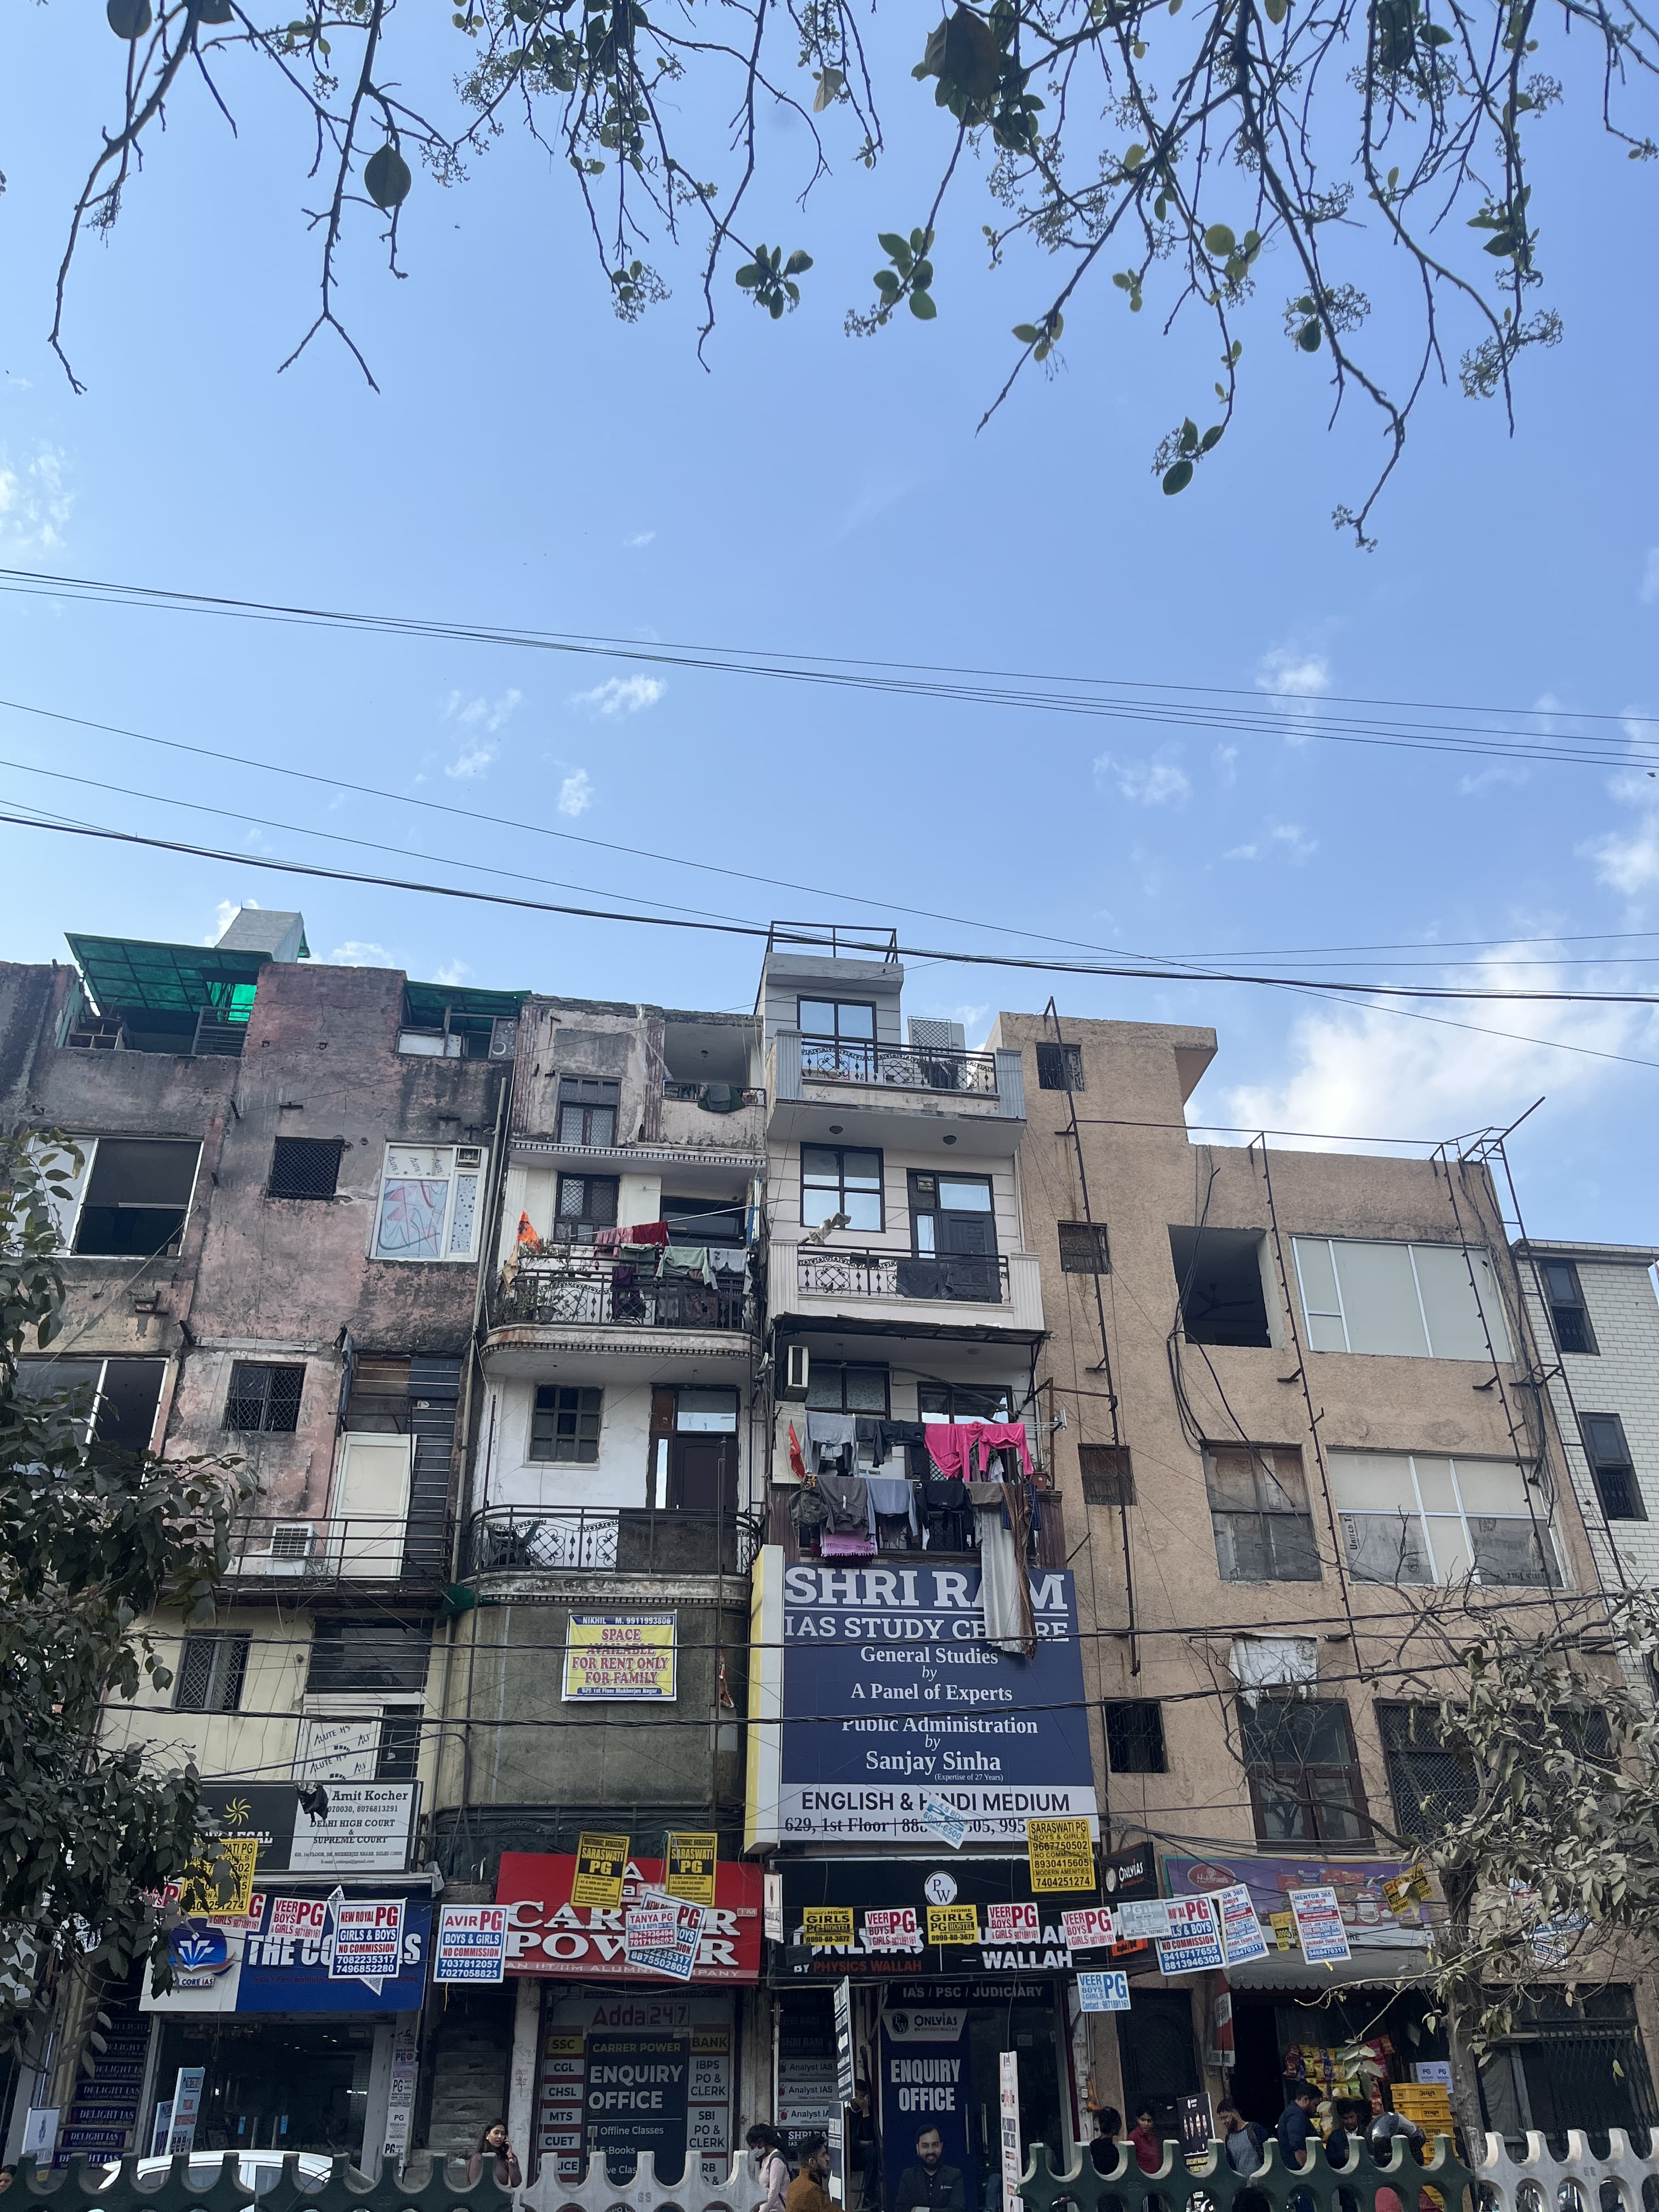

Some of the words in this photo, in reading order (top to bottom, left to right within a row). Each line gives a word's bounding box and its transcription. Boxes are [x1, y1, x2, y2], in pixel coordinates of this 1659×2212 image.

[785, 1566, 919, 1606] SHRI
[932, 1571, 1068, 1610] RM
[601, 1628, 641, 1641] SPACE
[785, 1616, 837, 1637] IAS
[844, 1617, 944, 1639] STUDY
[952, 1620, 1069, 1642] CERE
[586, 1643, 655, 1655] AVAILABLE
[860, 1646, 931, 1663] General
[935, 1647, 998, 1664] Studies
[572, 1657, 597, 1669] FOR
[600, 1657, 634, 1669] RENT
[637, 1657, 669, 1669] ONLY
[584, 1672, 610, 1684] FOR
[613, 1672, 658, 1684] FAMILY
[921, 1666, 938, 1682] by
[850, 1683, 866, 1699] A
[870, 1683, 919, 1700] Panel
[924, 1683, 941, 1700] of
[945, 1684, 1013, 1705] Experts
[842, 1716, 899, 1732] Public
[902, 1716, 1039, 1734] Administration
[924, 1734, 941, 1751] by
[866, 1750, 937, 1775] Sanjay
[943, 1751, 1002, 1771] Sinha
[934, 1773, 966, 1781] (Expertise
[984, 1774, 1003, 1782] Years)
[331, 1791, 362, 1801] Amit
[364, 1791, 409, 1801] Kocher
[802, 1792, 894, 1810] ENGLISH
[900, 1792, 913, 1810] &
[919, 1793, 980, 1810] HNDI
[984, 1793, 1070, 1811] MEDIUM
[309, 1819, 337, 1827] DELHI
[785, 1817, 816, 1834] 629,
[821, 1817, 843, 1832] 1st
[847, 1817, 889, 1832] Floor
[1031, 1822, 1075, 1834] SARASWATI
[1076, 1821, 1087, 1832] PG
[581, 1847, 624, 1862] SARASWATI
[589, 1860, 613, 1875] PG
[1034, 1859, 1090, 1869] 8930415605
[1036, 1876, 1090, 1888] 7404251274
[274, 1913, 295, 1923] BOYS
[276, 1900, 297, 1913] VEER
[296, 1902, 324, 1927] PG
[340, 1911, 355, 1923] NEW
[356, 1911, 374, 1922] ROYAL
[375, 1906, 399, 1927] PG
[508, 1901, 741, 1936] CARR
[630, 1914, 658, 1924] TANYA
[661, 1912, 673, 1922] PG
[930, 1913, 974, 1922] GIRLS
[989, 1906, 1011, 1918] VEER
[1011, 1905, 1037, 1928] PG
[445, 1916, 478, 1926] AVIR
[479, 1911, 503, 1931] PG
[930, 1922, 947, 1932] PG
[948, 1921, 975, 1931] HOSTEL
[991, 1919, 1012, 1929] BOYS
[275, 1924, 294, 1934] GIRLS
[340, 1931, 364, 1941] GIRLS
[366, 1930, 373, 1940] &
[375, 1929, 396, 1940] BOYS
[995, 1929, 1012, 1939] GIRLS
[445, 1934, 466, 1944] BOYS
[467, 1934, 473, 1944] &
[476, 1934, 500, 1944] GIRLS
[248, 1935, 297, 1966] THE
[338, 1945, 348, 1953] NO
[349, 1943, 394, 1953] COMMISSION
[443, 1948, 453, 1956] NO
[454, 1948, 499, 1957] COMMISSION
[506, 1931, 739, 1965] POWR
[1308, 1947, 1345, 1957] 9468470317
[337, 1955, 395, 1964] 7082235317
[981, 1950, 1073, 1970] WALLAH
[1163, 1948, 1218, 1961] 9416717655
[441, 1959, 499, 1968] 7037812057
[631, 1951, 688, 1974] 8875502802
[813, 1960, 867, 1973] PHYSICS
[870, 1960, 922, 1972] WALLAH
[1165, 1954, 1221, 1970] 8813946309
[336, 1964, 394, 1973] 7496852280
[441, 1969, 498, 1977] 7027058823
[903, 1987, 925, 1997] IAS
[936, 1987, 962, 1997] PSC
[973, 1986, 1043, 1997] JUDICIARY
[1079, 1975, 1103, 1986] VEER
[1104, 1973, 1127, 1999] PG
[552, 2039, 575, 2050] SSC
[592, 2042, 636, 2053] CARRER
[639, 2042, 681, 2052] POWER
[692, 2037, 728, 2049] BANK
[554, 2063, 574, 2073] CGL
[696, 2060, 719, 2070] IBPS
[789, 2063, 820, 2072] Analyst
[590, 2064, 684, 2086] ENQUIRY
[890, 2059, 961, 2085] ENQUIRY
[696, 2073, 710, 2084] PO
[714, 2073, 721, 2083] &
[393, 2079, 403, 2092] PG
[691, 2086, 726, 2096] CLERK
[788, 2086, 819, 2095] Analyst
[548, 2087, 577, 2097] CHSL
[588, 2090, 663, 2109] OFFICE
[899, 2087, 956, 2112] OFFICE
[80, 2109, 117, 2119] DELIGHT
[549, 2112, 573, 2121] MTS
[698, 2111, 715, 2120] SBI
[600, 2126, 630, 2136] Offline
[631, 2126, 664, 2135] Classes
[694, 2125, 710, 2135] PO
[713, 2125, 720, 2135] &
[70, 2132, 105, 2141] DELIGHT
[105, 2132, 119, 2140] IAS
[545, 2136, 574, 2146] CUET
[689, 2137, 725, 2148] CLERK
